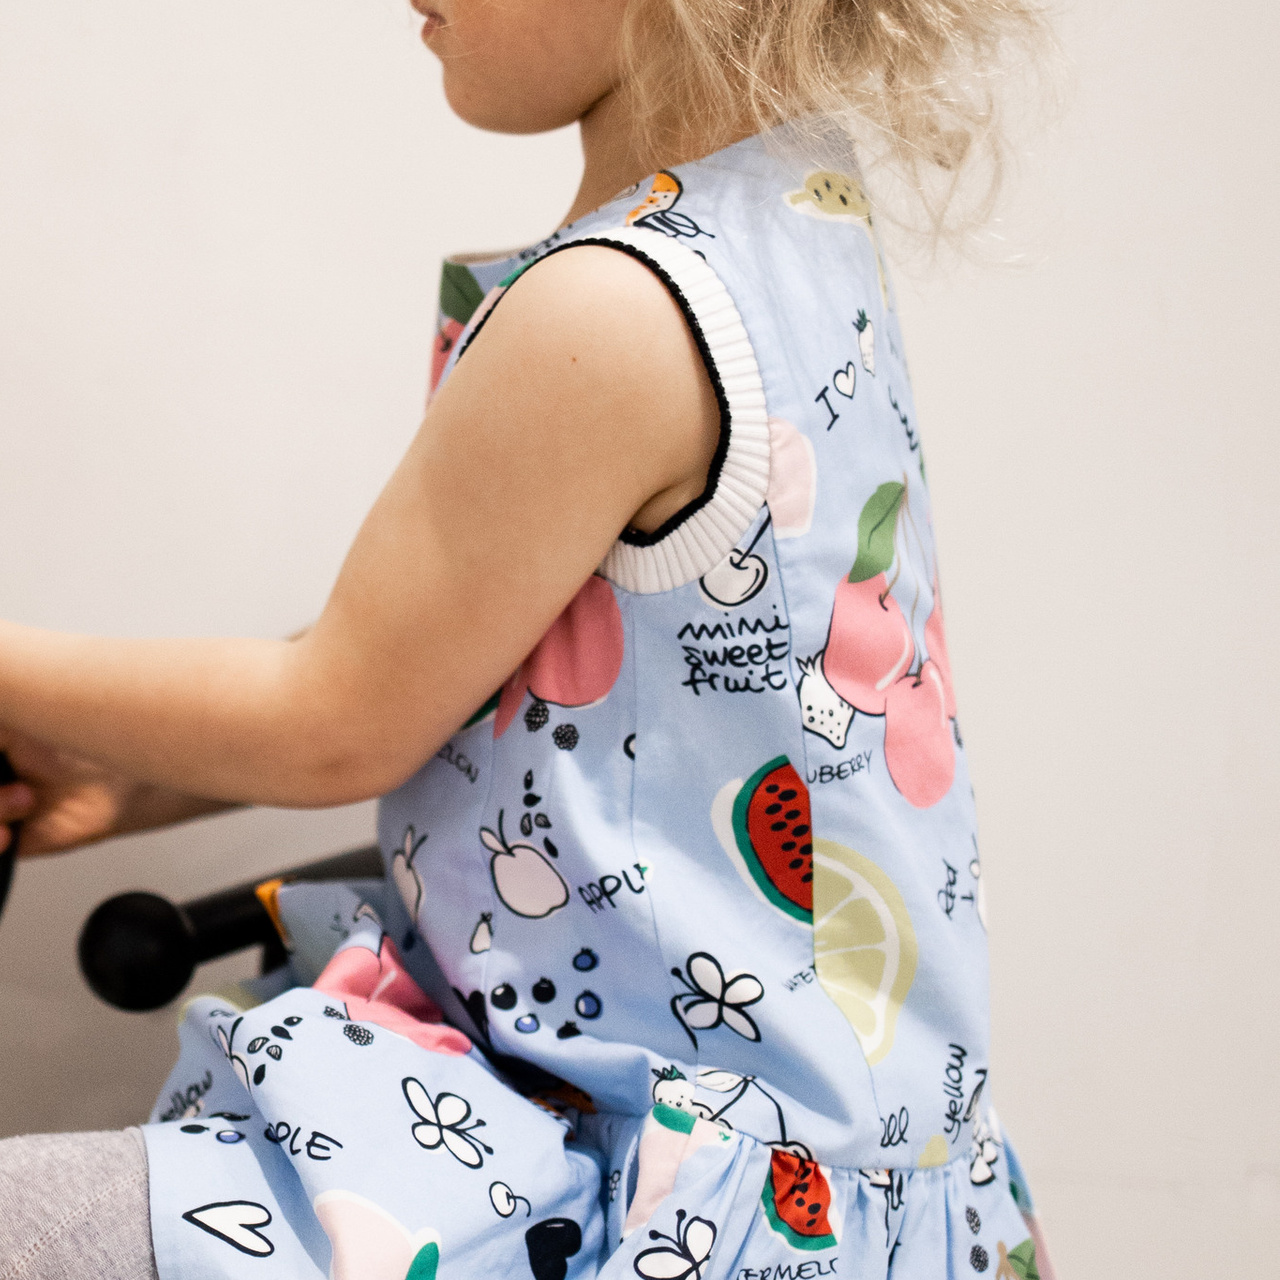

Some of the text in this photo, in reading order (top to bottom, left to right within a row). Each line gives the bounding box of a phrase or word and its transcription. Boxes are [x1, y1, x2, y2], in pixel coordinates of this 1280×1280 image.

[677, 605, 789, 640] mimi
[682, 638, 789, 667] sweet
[682, 663, 787, 696] fruit
[944, 1043, 968, 1145] yellow
